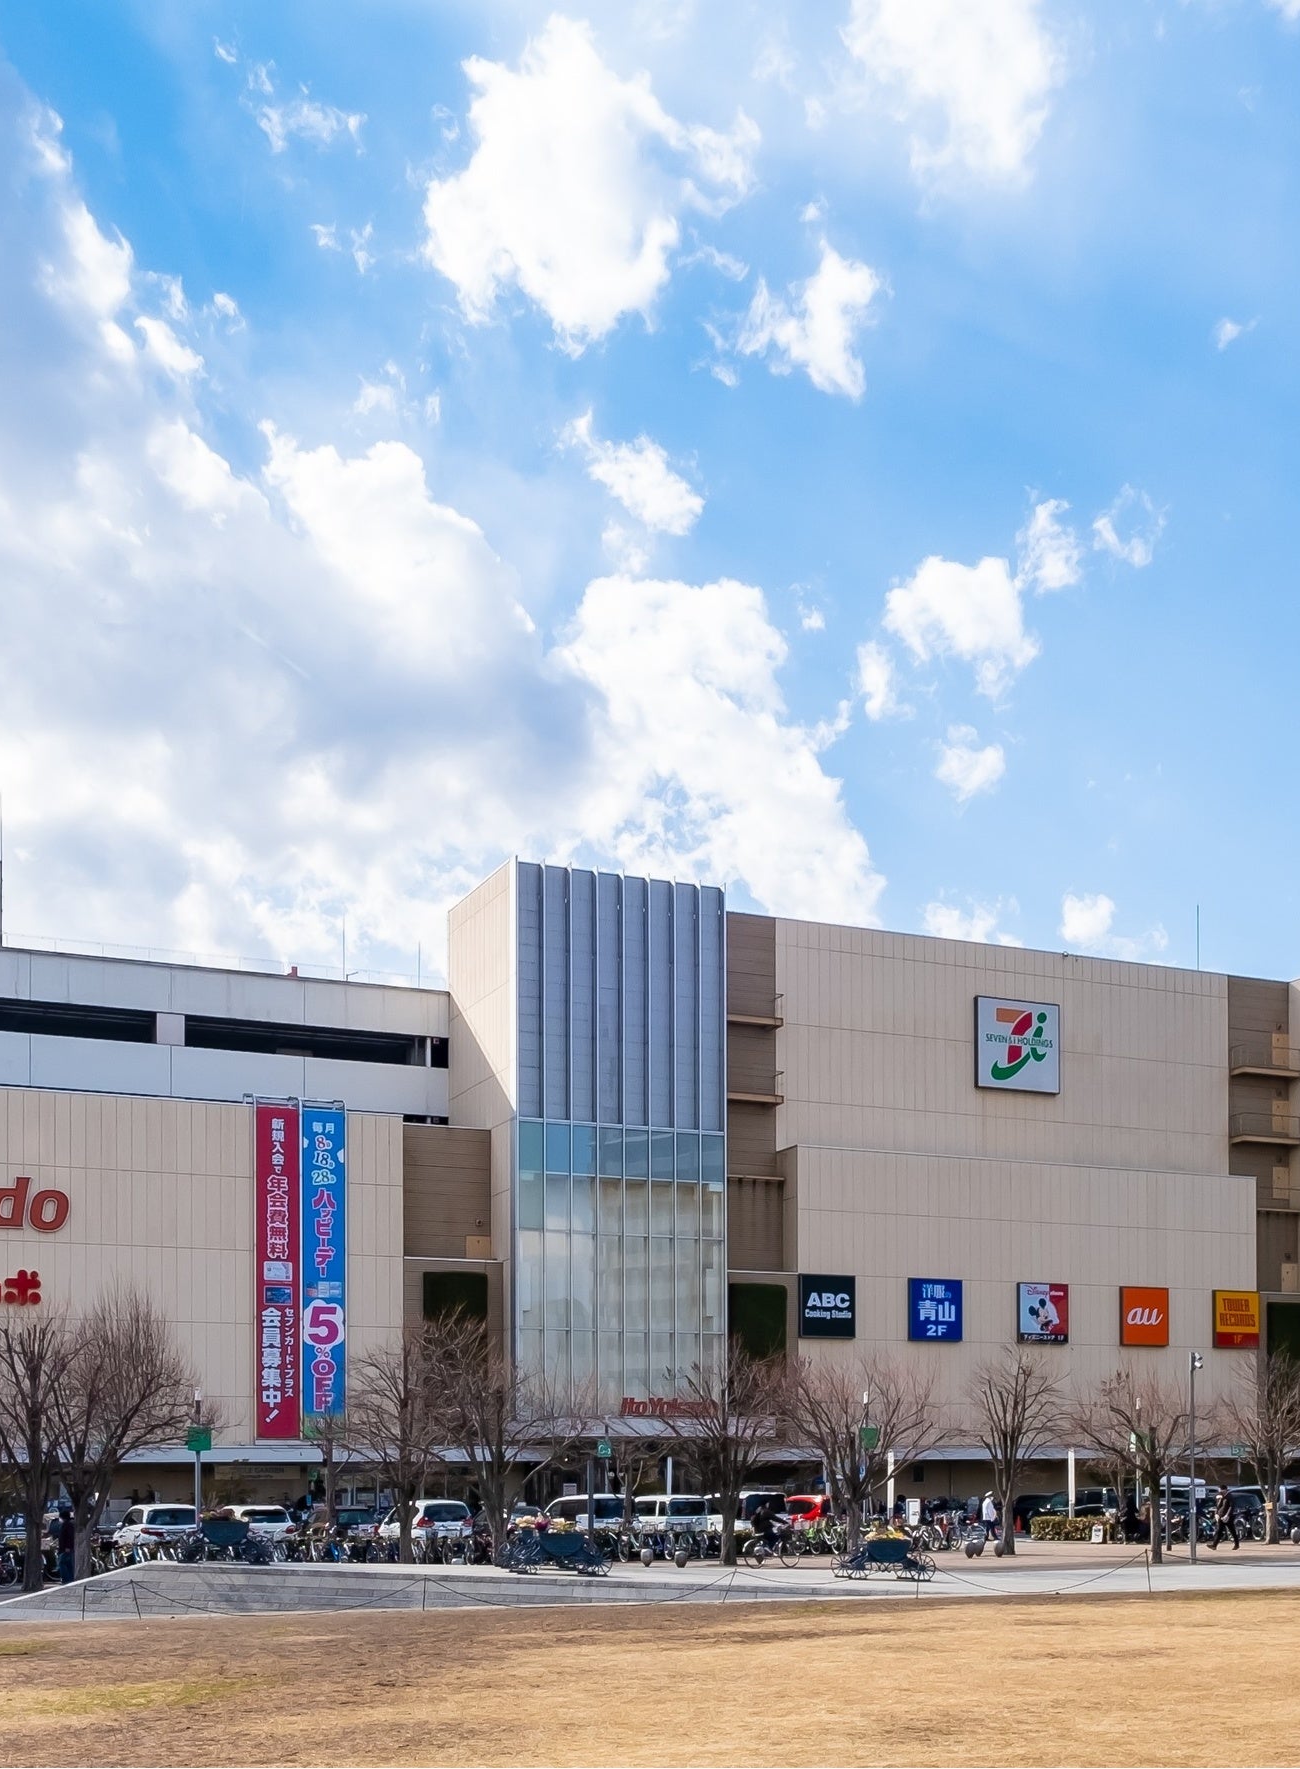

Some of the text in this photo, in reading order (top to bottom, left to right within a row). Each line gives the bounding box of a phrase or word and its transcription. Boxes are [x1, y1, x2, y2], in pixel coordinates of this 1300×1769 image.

[986, 1033, 1007, 1043] SEVEN
[1017, 1037, 1053, 1048] HOLDINGS
[311, 1187, 337, 1278] ハッピーデー
[807, 1292, 850, 1308] ABC
[1221, 1298, 1250, 1312] TOWER
[804, 1309, 852, 1320] Cooking Studio
[917, 1300, 956, 1322] 青山
[1126, 1307, 1164, 1326] au
[1219, 1312, 1256, 1328] RECORDS
[926, 1324, 948, 1336] 2F
[1233, 1334, 1243, 1344] 1F
